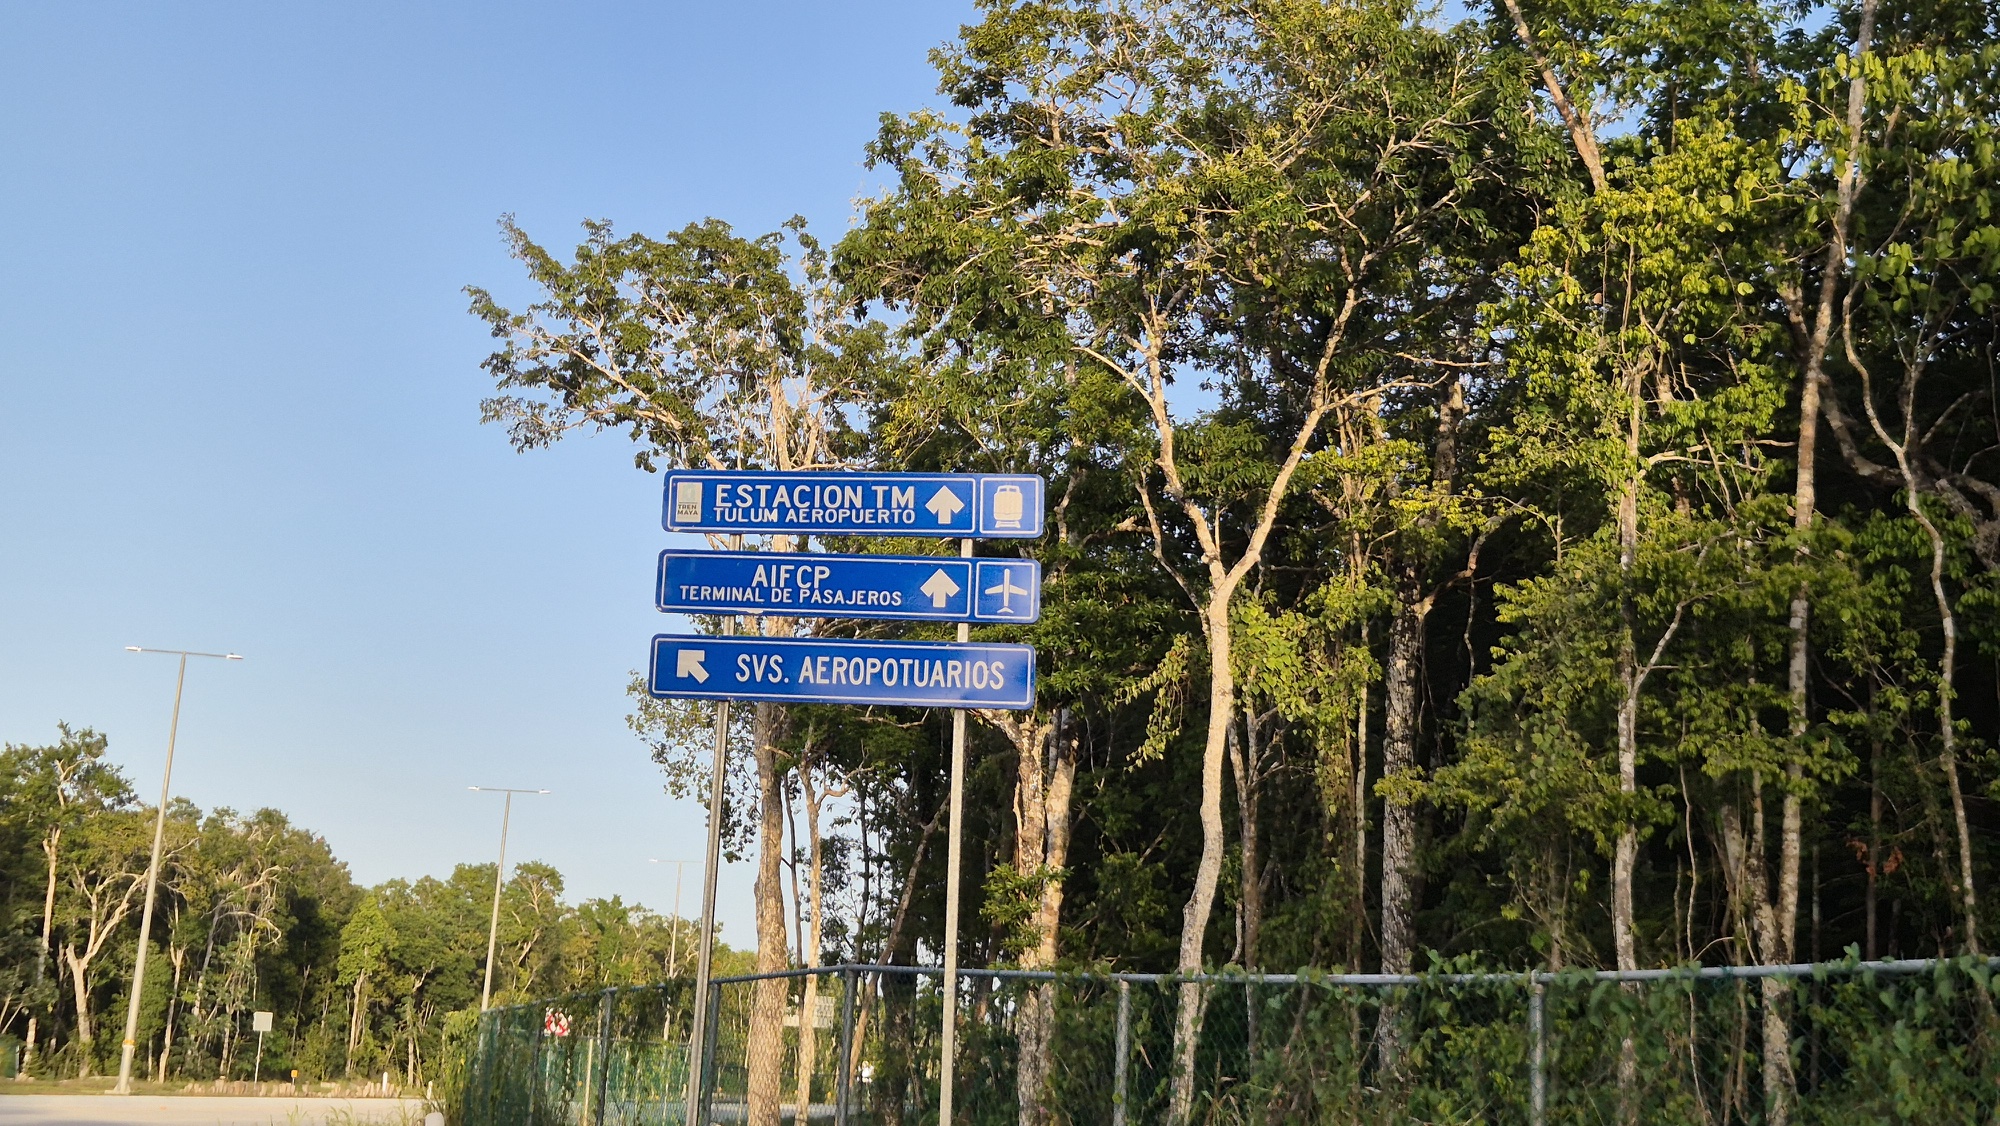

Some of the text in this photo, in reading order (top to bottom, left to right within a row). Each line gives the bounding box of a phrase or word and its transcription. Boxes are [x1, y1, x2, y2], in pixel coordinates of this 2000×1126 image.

[715, 484, 915, 509] ESTACION TM
[713, 508, 915, 524] TULUM AEROPUERTO
[751, 564, 830, 589] AIFCP
[680, 586, 902, 606] TERMINAL DE PASAJEROS
[735, 653, 1005, 690] SVS. AEROPOTUARIOS
